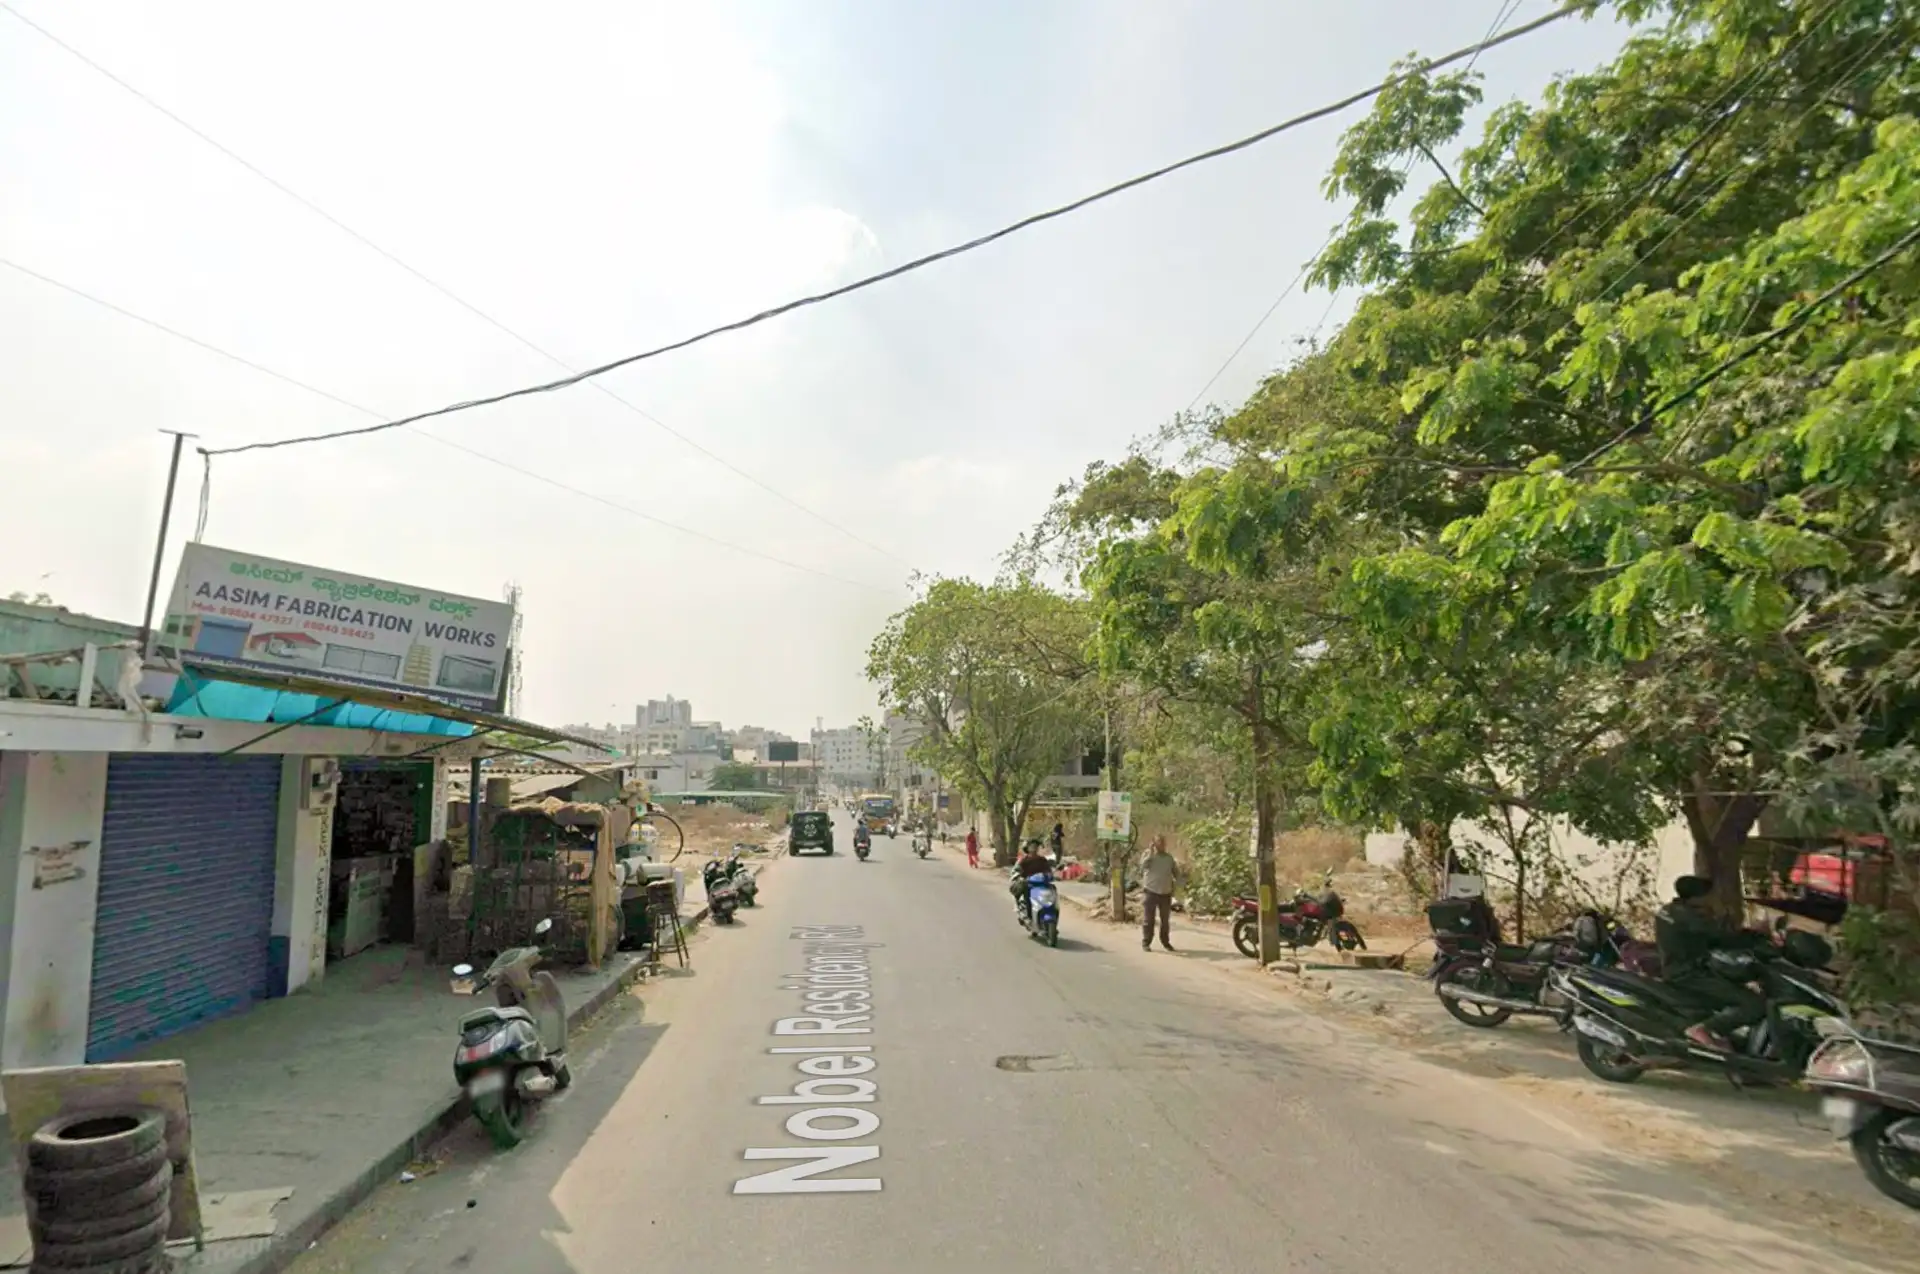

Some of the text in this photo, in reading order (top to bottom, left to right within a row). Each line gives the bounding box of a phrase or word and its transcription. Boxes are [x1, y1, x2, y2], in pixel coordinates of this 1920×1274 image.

[196, 581, 497, 648] AASIM FABRICATION WORKS
